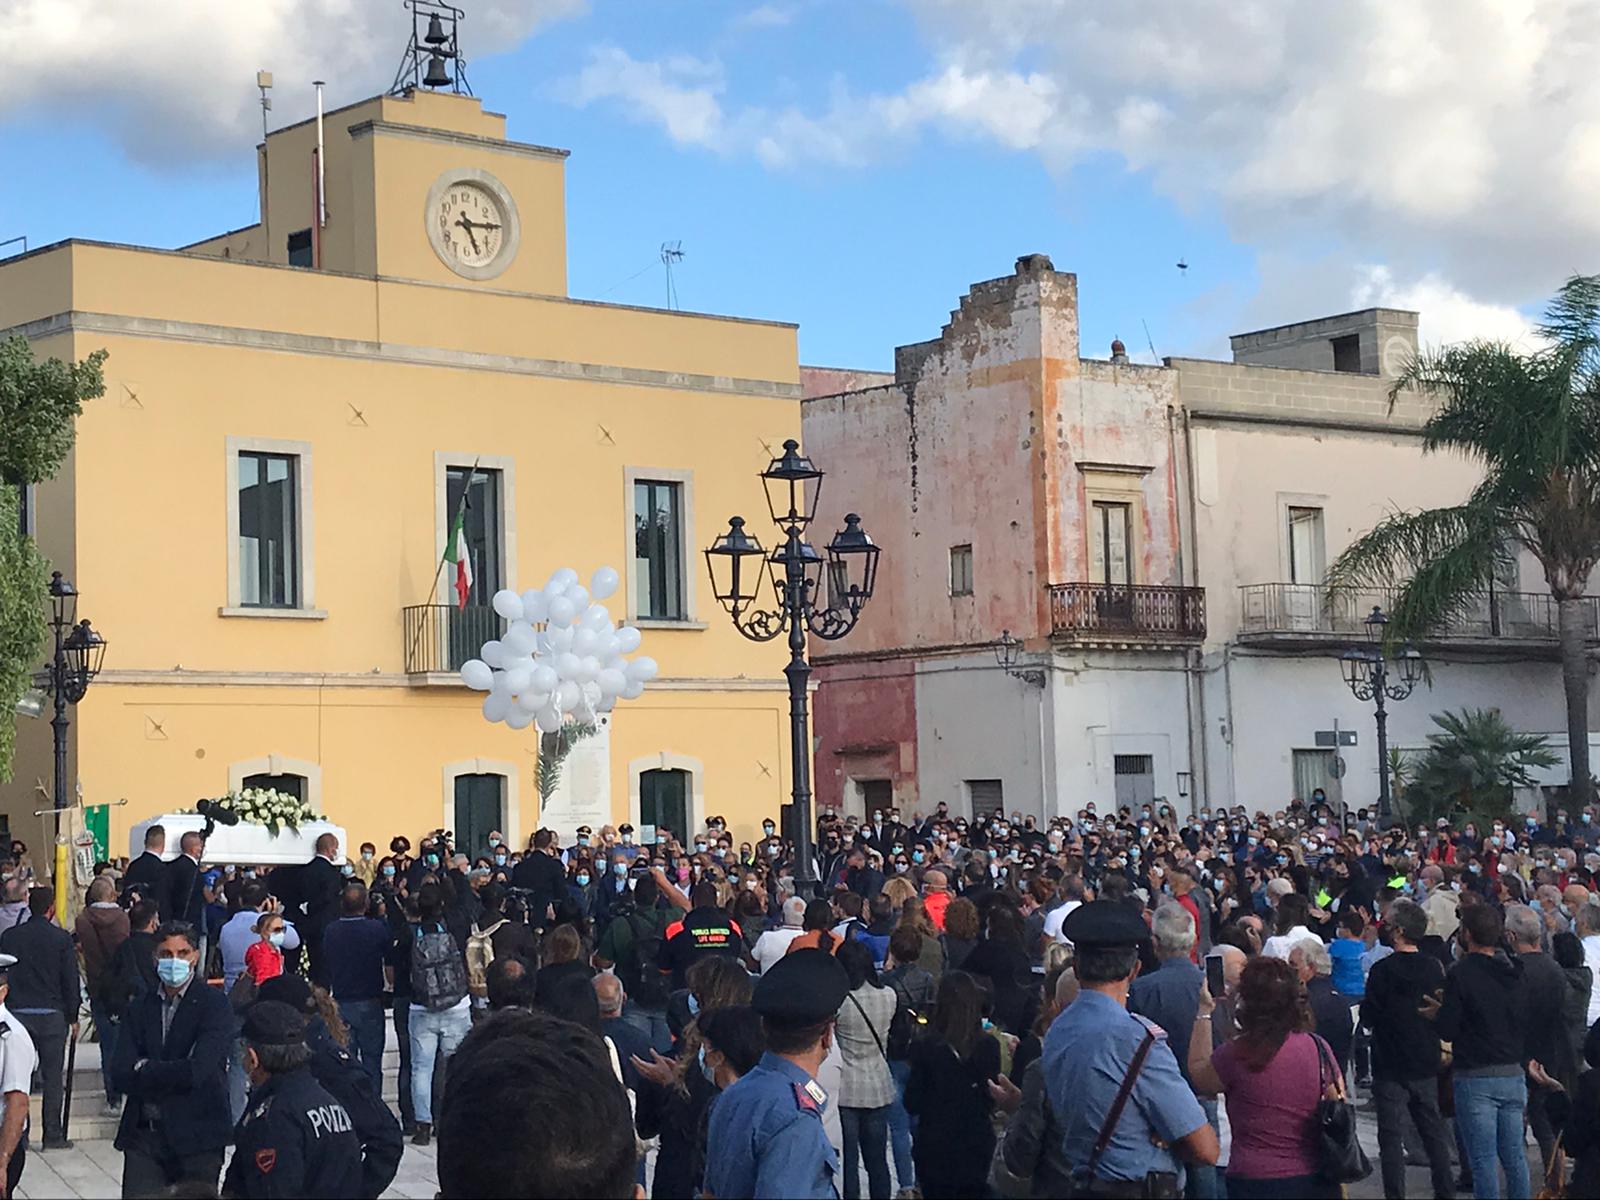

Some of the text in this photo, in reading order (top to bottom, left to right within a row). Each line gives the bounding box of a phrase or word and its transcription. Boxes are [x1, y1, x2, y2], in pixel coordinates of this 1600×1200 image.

[451, 194, 457, 205] 11
[461, 192, 470, 203] 12
[441, 202, 451, 215] 10
[482, 207, 489, 219] 2
[440, 215, 446, 228] 9
[482, 235, 490, 248] 4
[463, 247, 471, 257] 6
